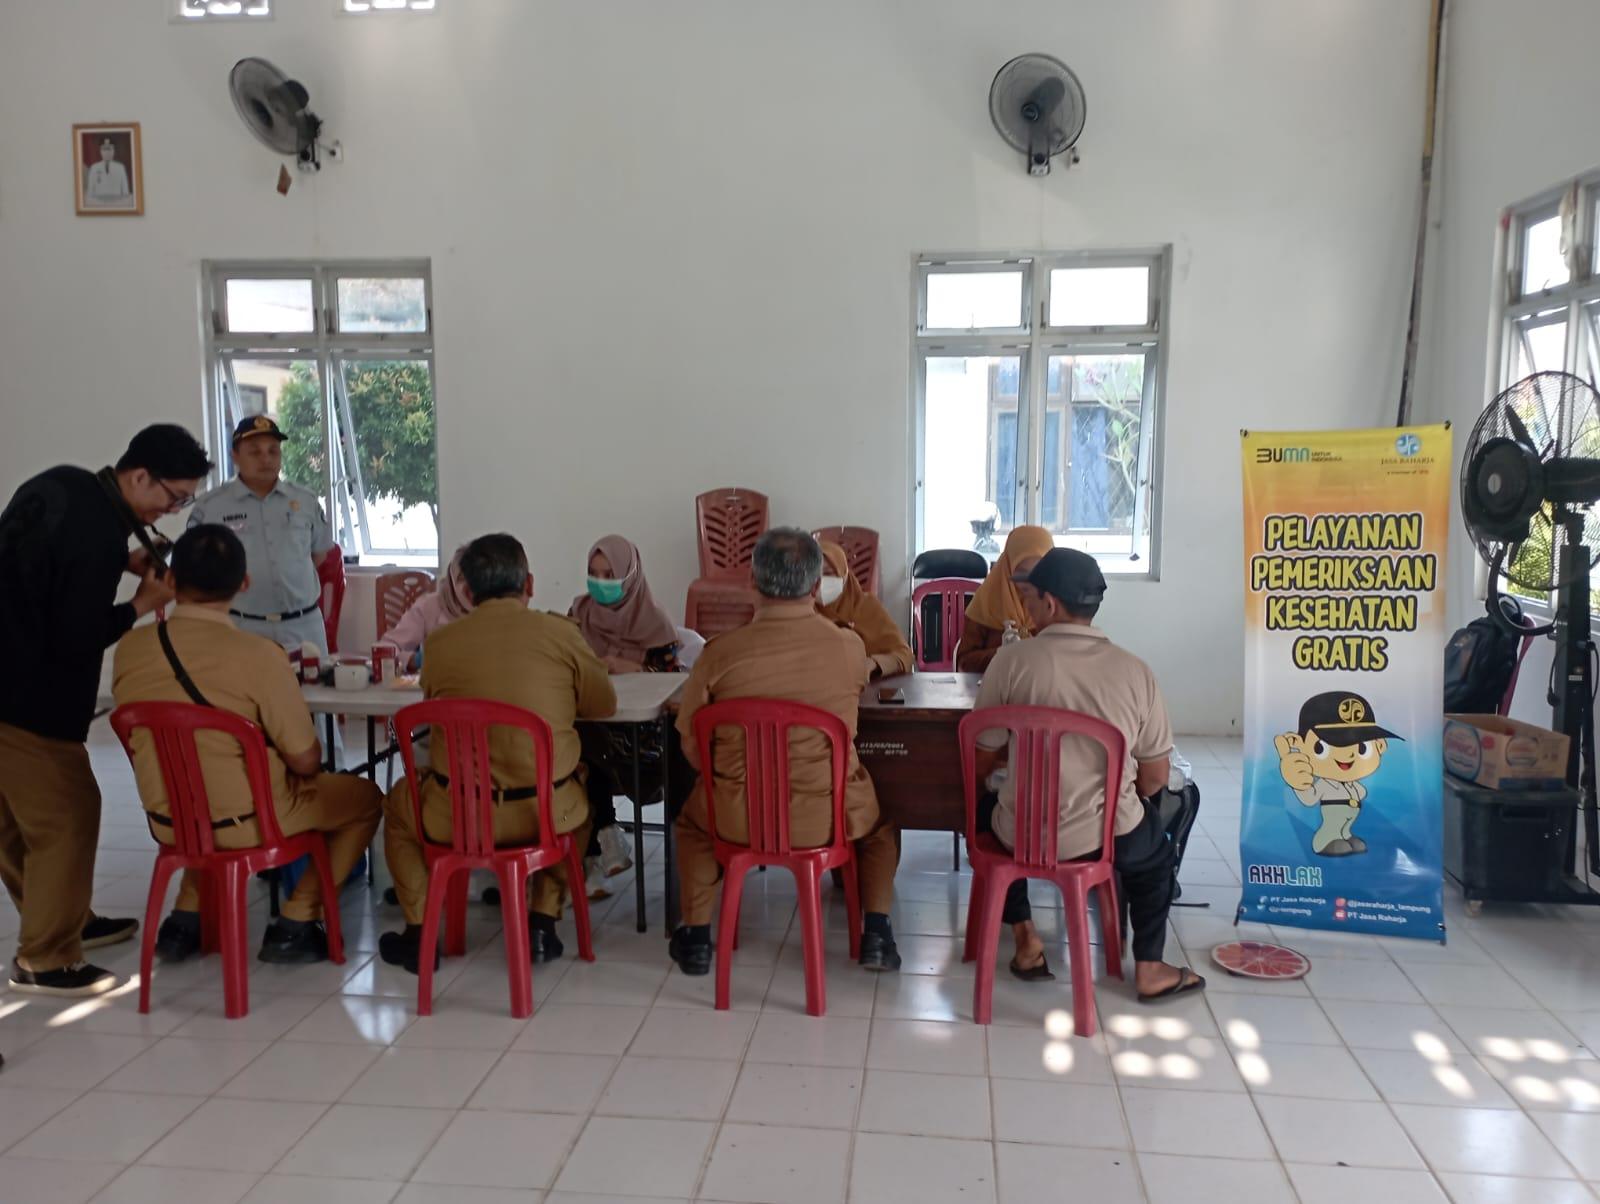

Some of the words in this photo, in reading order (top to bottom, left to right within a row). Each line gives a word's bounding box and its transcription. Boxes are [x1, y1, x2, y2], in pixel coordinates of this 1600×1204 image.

[1265, 513, 1422, 551] PELAYANAN
[1252, 554, 1436, 591] PEMERIKSAAN
[1266, 595, 1417, 631] KESEHATAN
[1293, 635, 1388, 671] GRATIS
[1249, 864, 1322, 887] AKHLAK
[1299, 897, 1327, 905] Raharja
[1347, 912, 1358, 920] PT
[1359, 913, 1378, 921] Jasa
[1378, 914, 1408, 924] Raharja
